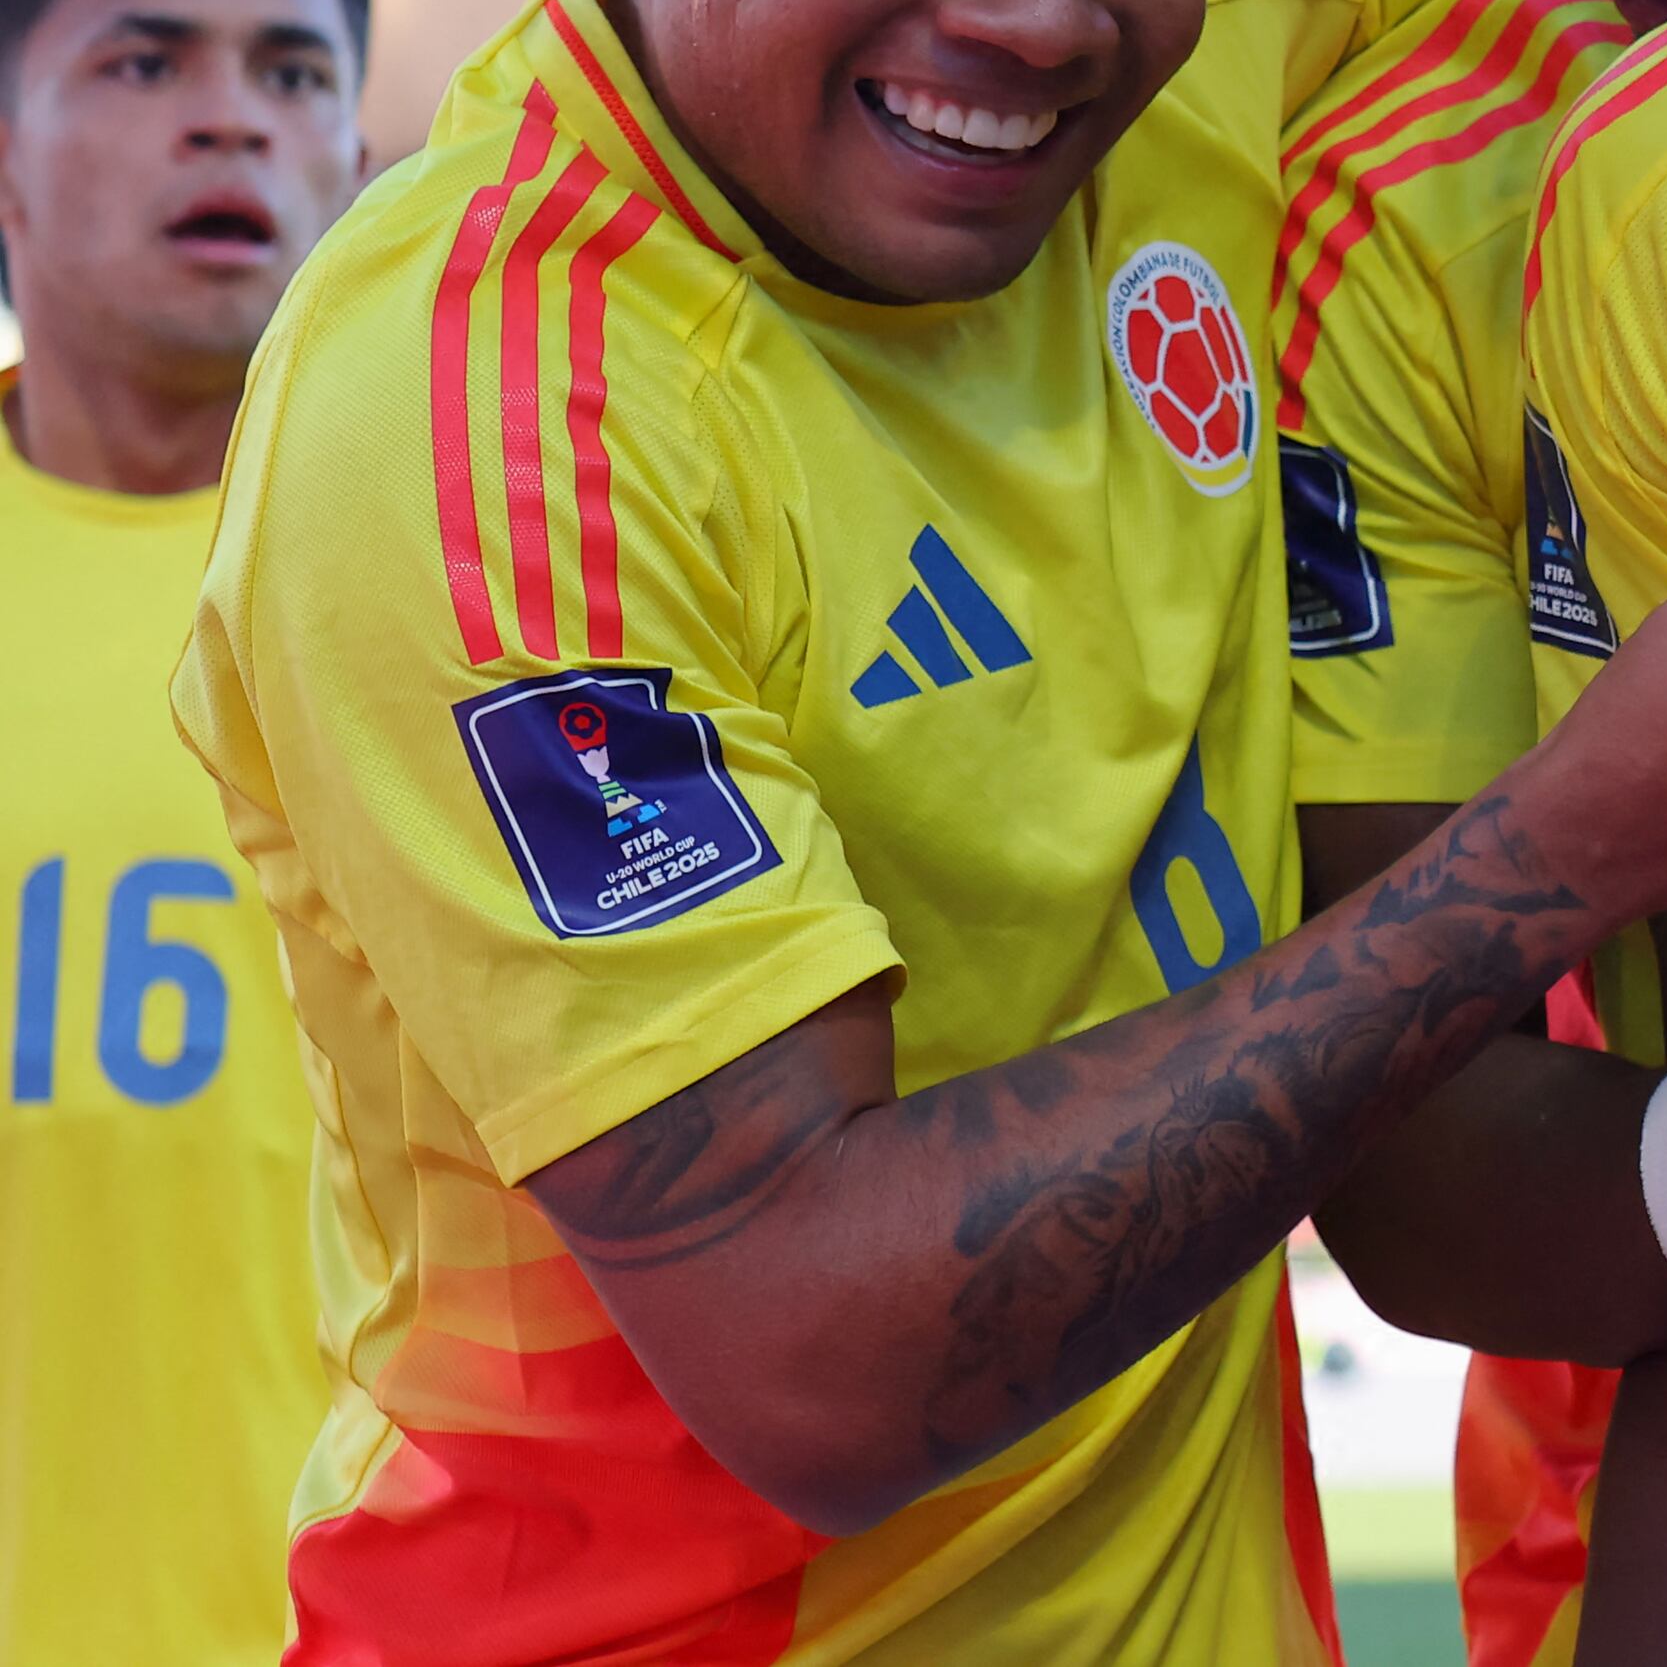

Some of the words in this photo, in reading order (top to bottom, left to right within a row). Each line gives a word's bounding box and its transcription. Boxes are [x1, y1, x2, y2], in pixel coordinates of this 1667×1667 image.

[1543, 562, 1575, 586] FIFA
[1529, 594, 1562, 617] HILE
[605, 864, 634, 885] U-20
[632, 846, 676, 873] WORLD
[674, 835, 696, 853] CUP
[620, 827, 670, 860] FIFA
[596, 867, 668, 910] CHILE
[662, 841, 720, 882] 2025
[12, 852, 238, 1109] 16
